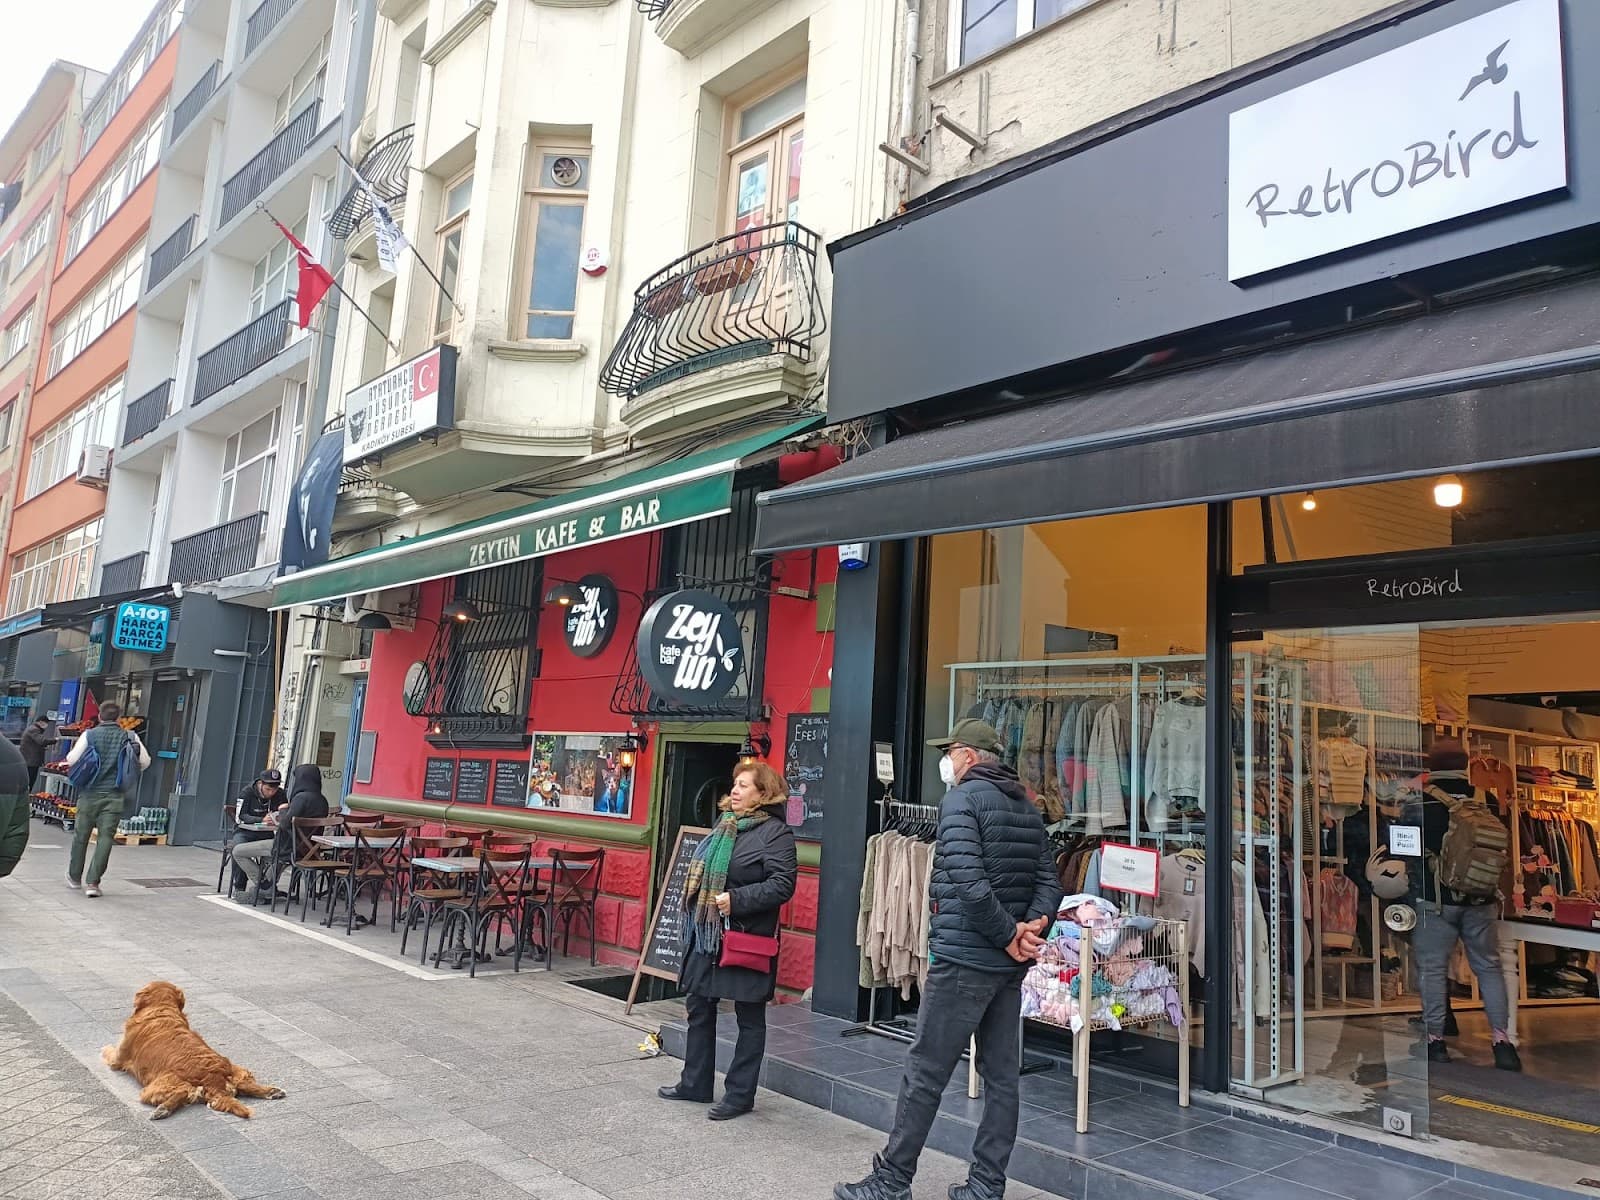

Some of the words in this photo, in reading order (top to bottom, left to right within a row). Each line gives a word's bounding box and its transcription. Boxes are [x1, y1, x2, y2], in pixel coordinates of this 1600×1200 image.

[535, 519, 578, 552] KAFE
[589, 516, 606, 538] &
[620, 497, 661, 532] BAR
[121, 618, 164, 630] HARCA
[120, 628, 163, 640] HARCA
[660, 643, 681, 657] kafe
[660, 655, 676, 665] bar
